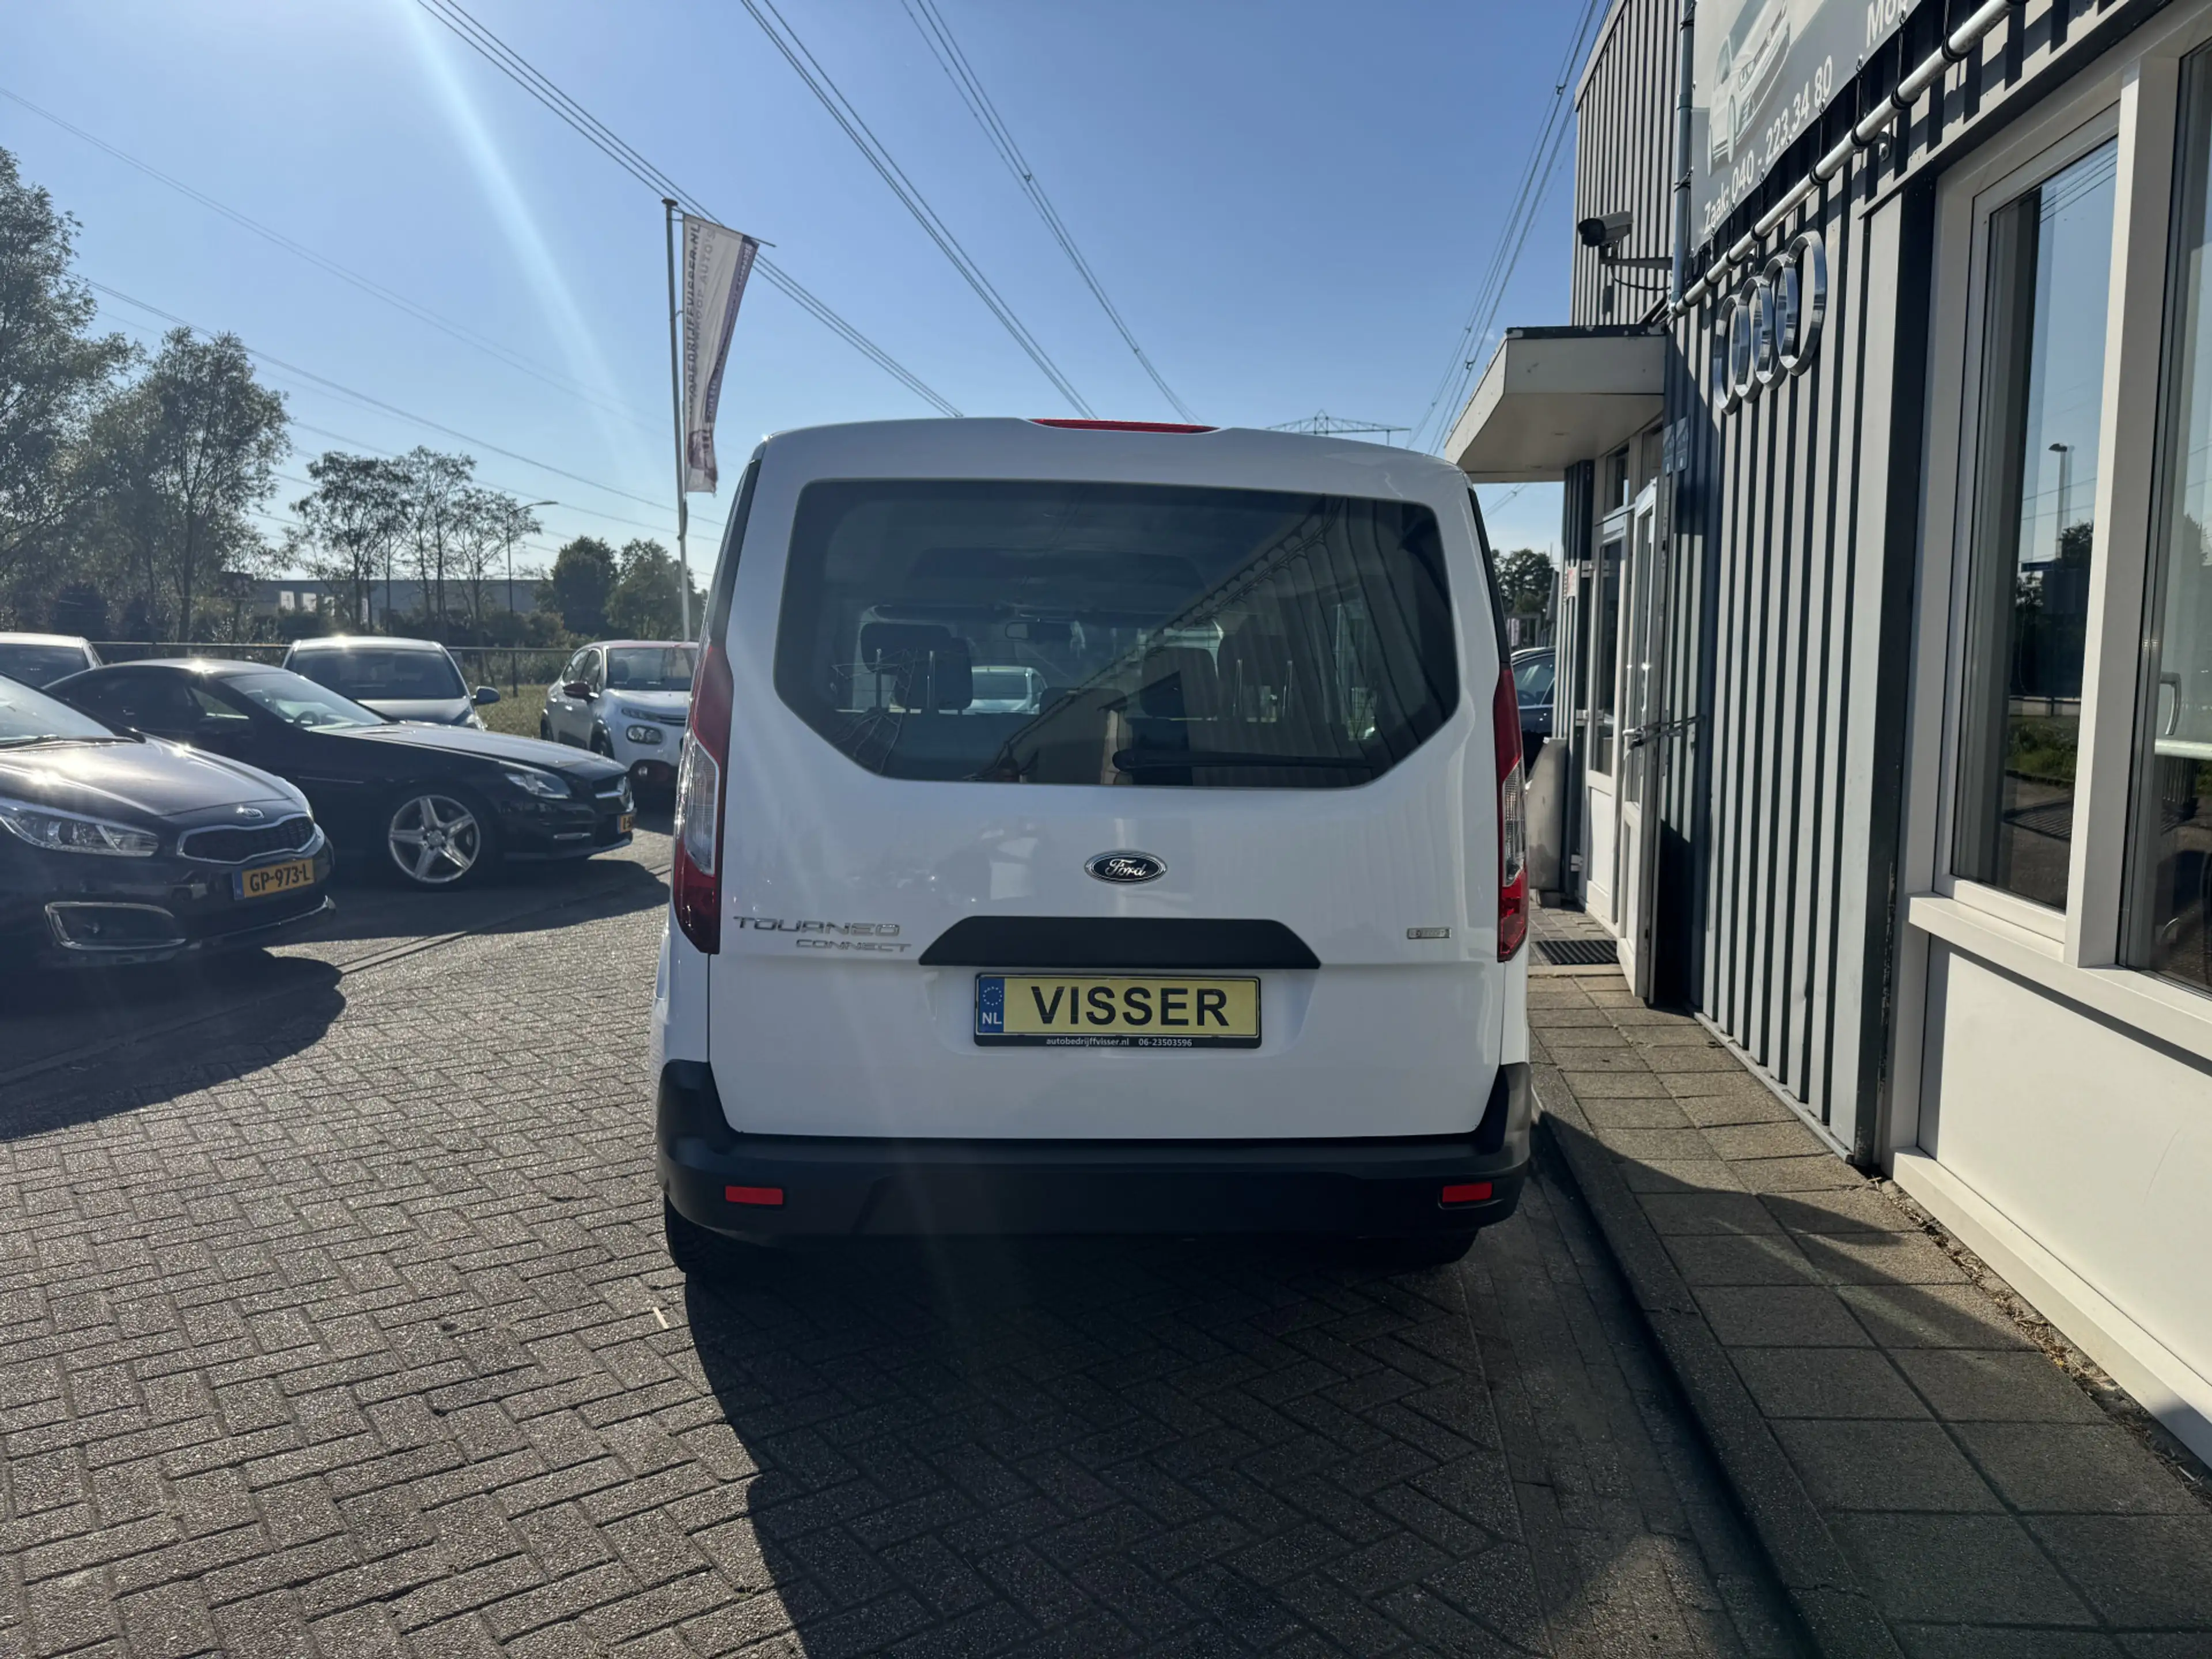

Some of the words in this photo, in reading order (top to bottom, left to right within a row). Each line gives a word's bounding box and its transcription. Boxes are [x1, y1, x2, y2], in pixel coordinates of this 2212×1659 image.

[1703, 182, 1729, 234] Zaak:
[1732, 150, 1754, 203] 040
[1104, 858, 1147, 876] Ford
[249, 863, 310, 892] GP-973-L
[733, 915, 900, 937] TOURNEO
[796, 938, 912, 953] CONNECT
[1030, 986, 1230, 1027] VISSER
[982, 1012, 1002, 1025] NL
[1046, 1037, 1130, 1047] autobedrijffvisser.nl
